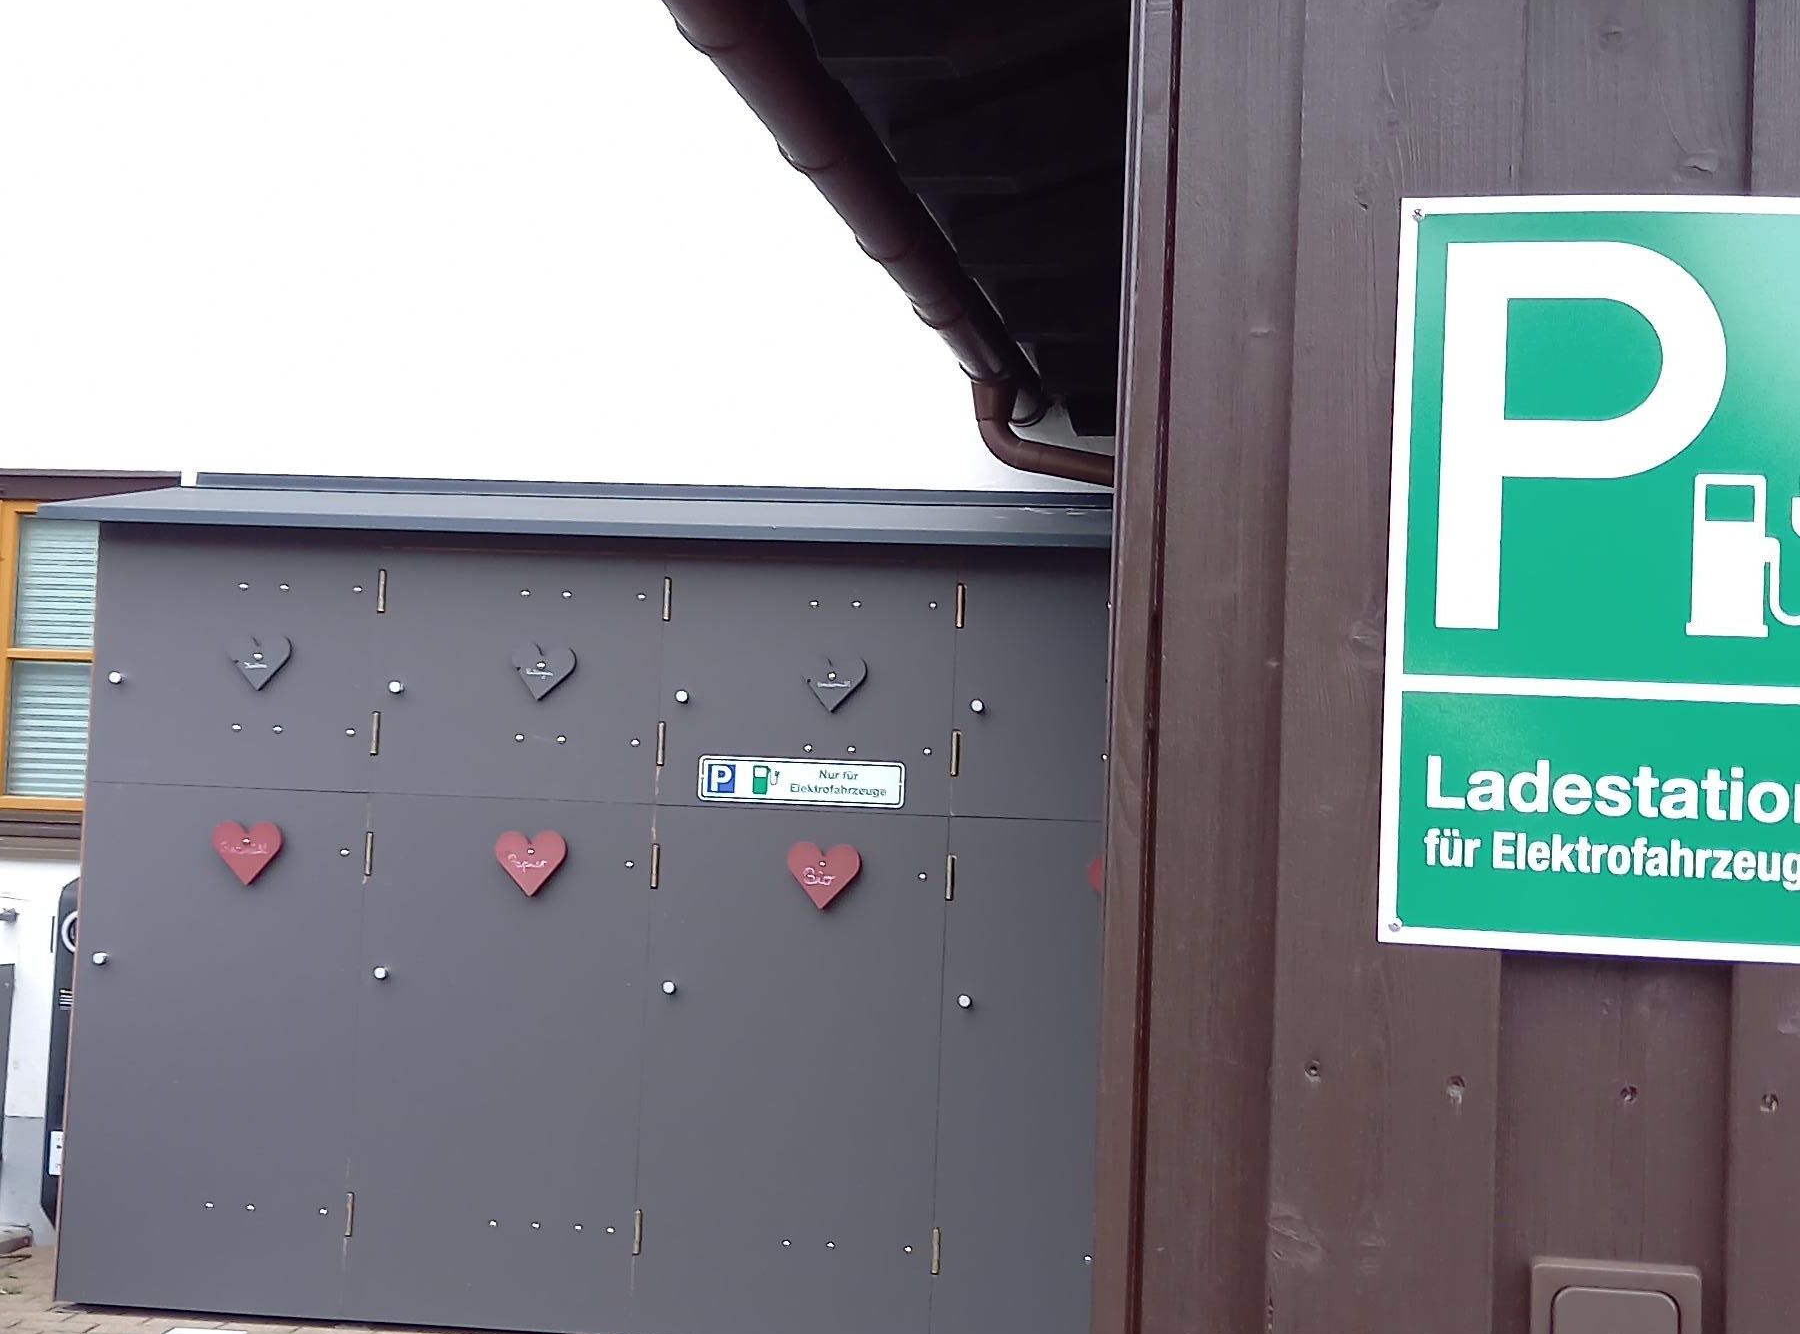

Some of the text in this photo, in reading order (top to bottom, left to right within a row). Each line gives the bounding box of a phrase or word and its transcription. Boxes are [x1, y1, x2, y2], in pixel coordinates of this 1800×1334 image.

[1435, 241, 1728, 630] P
[710, 764, 733, 792] P
[789, 783, 887, 798] Elektrofahrzeuge
[819, 769, 858, 780] Nur für
[1427, 755, 1800, 824] Ladestatio
[1424, 827, 1481, 868] für
